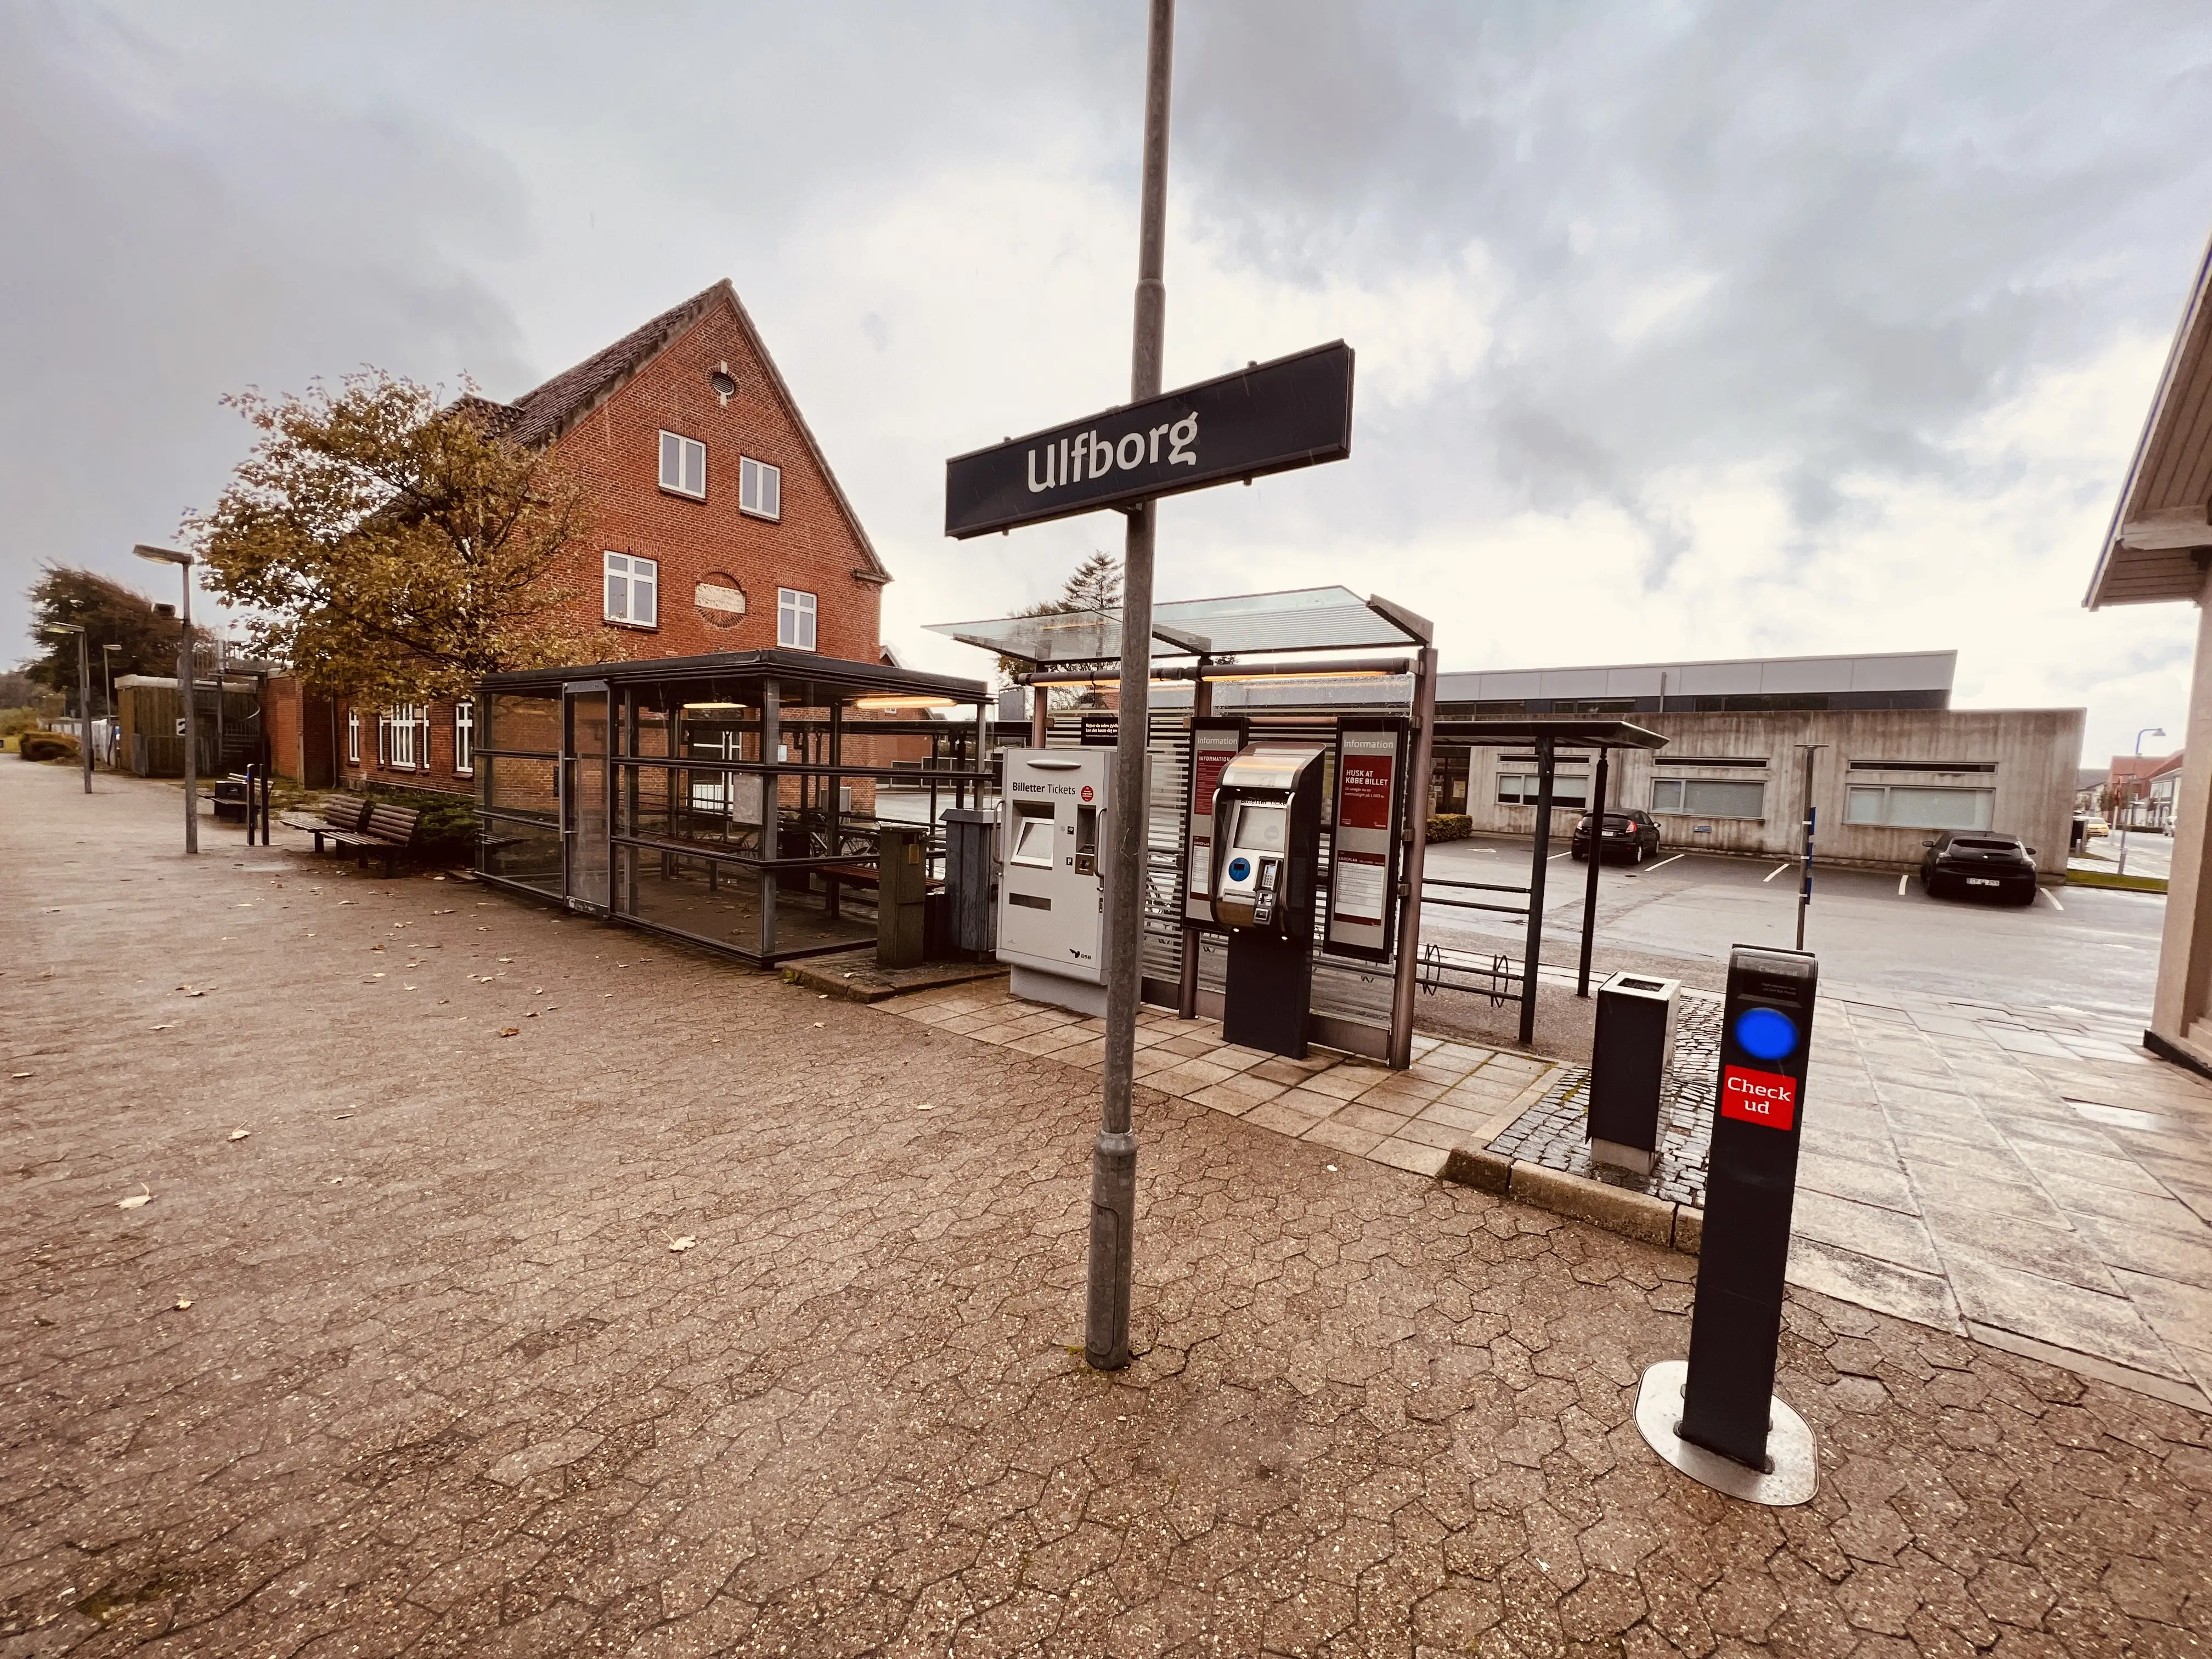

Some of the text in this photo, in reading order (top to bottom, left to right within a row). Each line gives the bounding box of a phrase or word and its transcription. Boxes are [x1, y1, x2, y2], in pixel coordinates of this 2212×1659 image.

[1028, 411, 1198, 493] Ulfborg
[1197, 736, 1238, 745] Information
[1344, 739, 1393, 748] Information
[1012, 782, 1045, 793] Billetter
[1047, 783, 1076, 795] Tickets
[1365, 778, 1389, 786] BILLET
[1728, 1076, 1791, 1102] Check
[1744, 1099, 1770, 1115] ud
